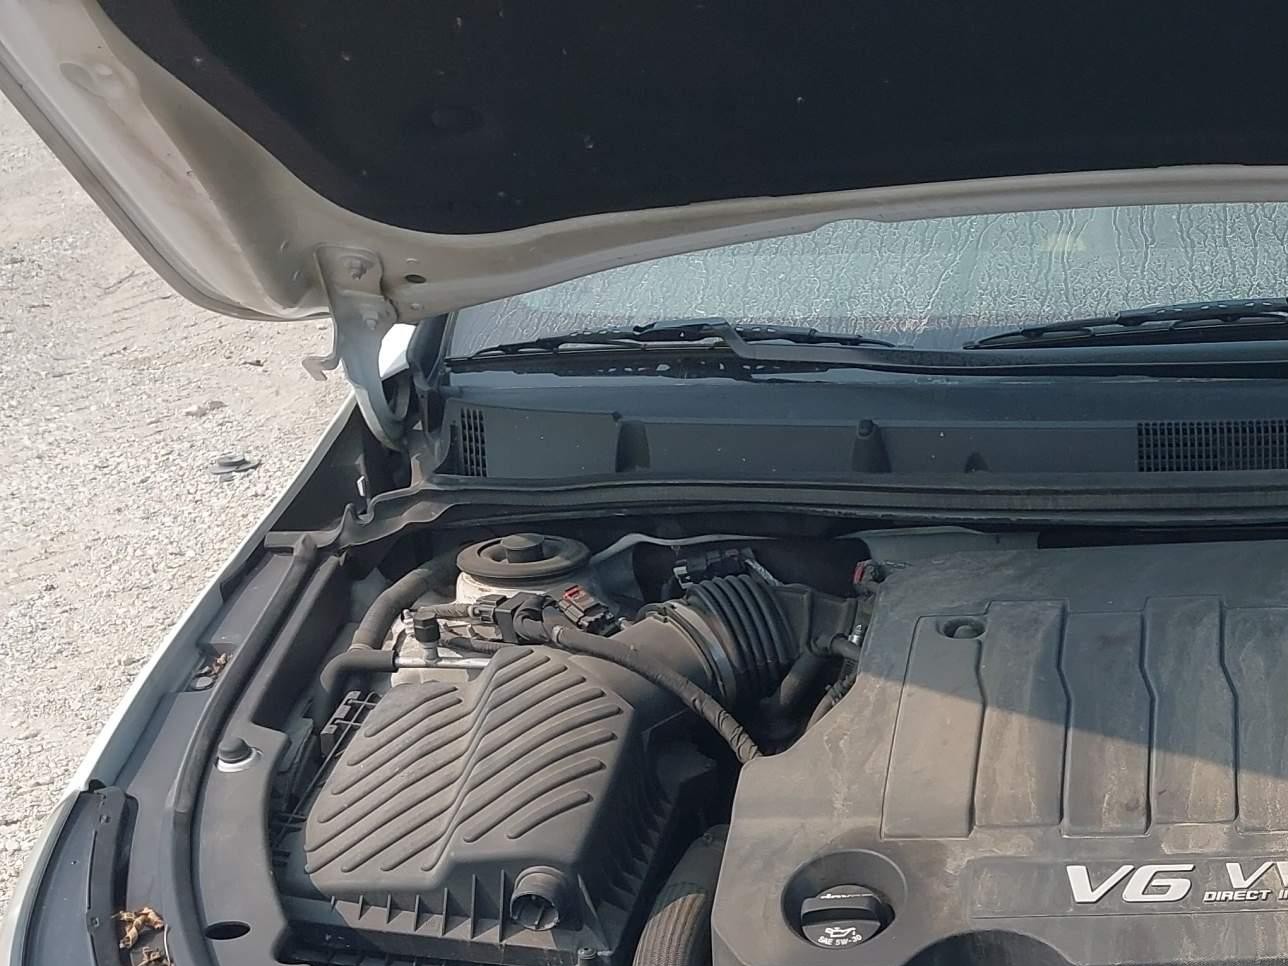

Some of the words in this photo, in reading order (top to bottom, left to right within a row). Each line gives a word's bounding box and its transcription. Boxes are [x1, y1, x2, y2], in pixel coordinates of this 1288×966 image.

[1066, 863, 1196, 904] V6
[1203, 889, 1271, 902] DIRECT
[835, 934, 863, 946] 5W-30
